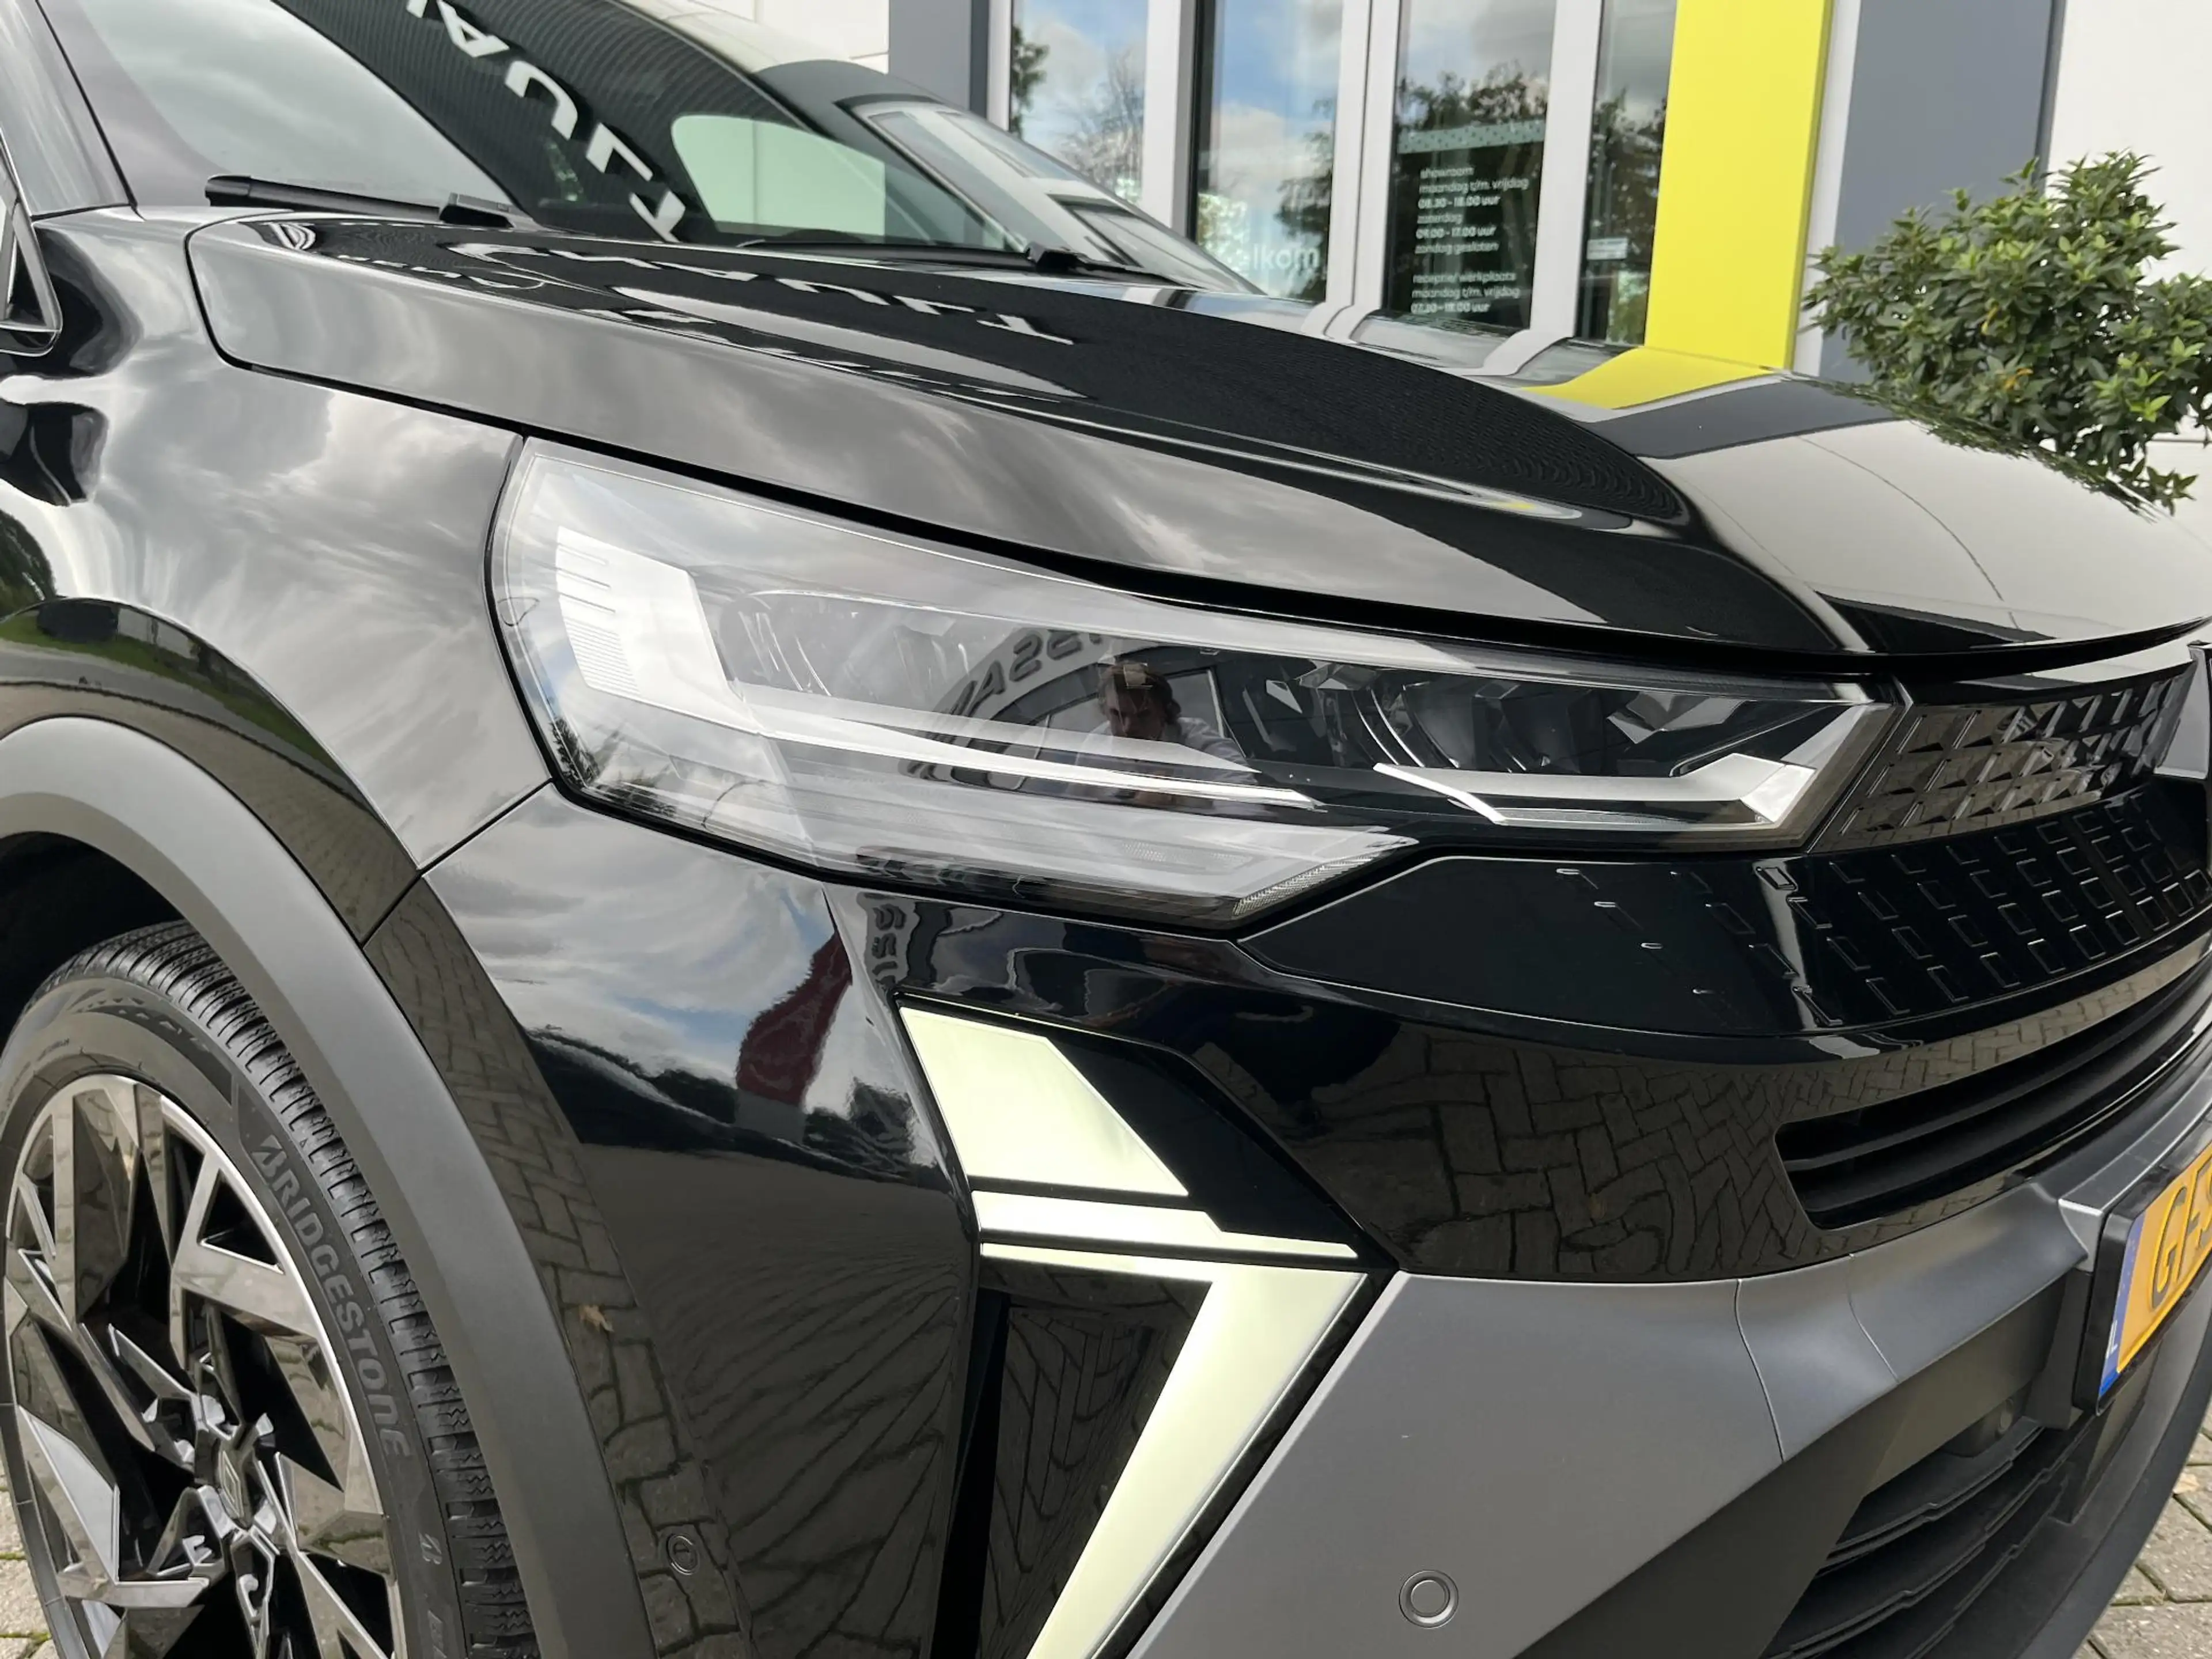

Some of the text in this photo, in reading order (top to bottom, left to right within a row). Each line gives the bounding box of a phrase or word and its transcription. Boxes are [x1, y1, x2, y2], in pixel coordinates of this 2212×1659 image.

[1420, 168, 1474, 179] showroom
[1419, 184, 1467, 194] maandag
[1491, 178, 1529, 191] vrijdag
[1412, 289, 1460, 299] maandag
[1484, 286, 1520, 299] vrijdag
[252, 1134, 411, 1457] BRIDGESTONE
